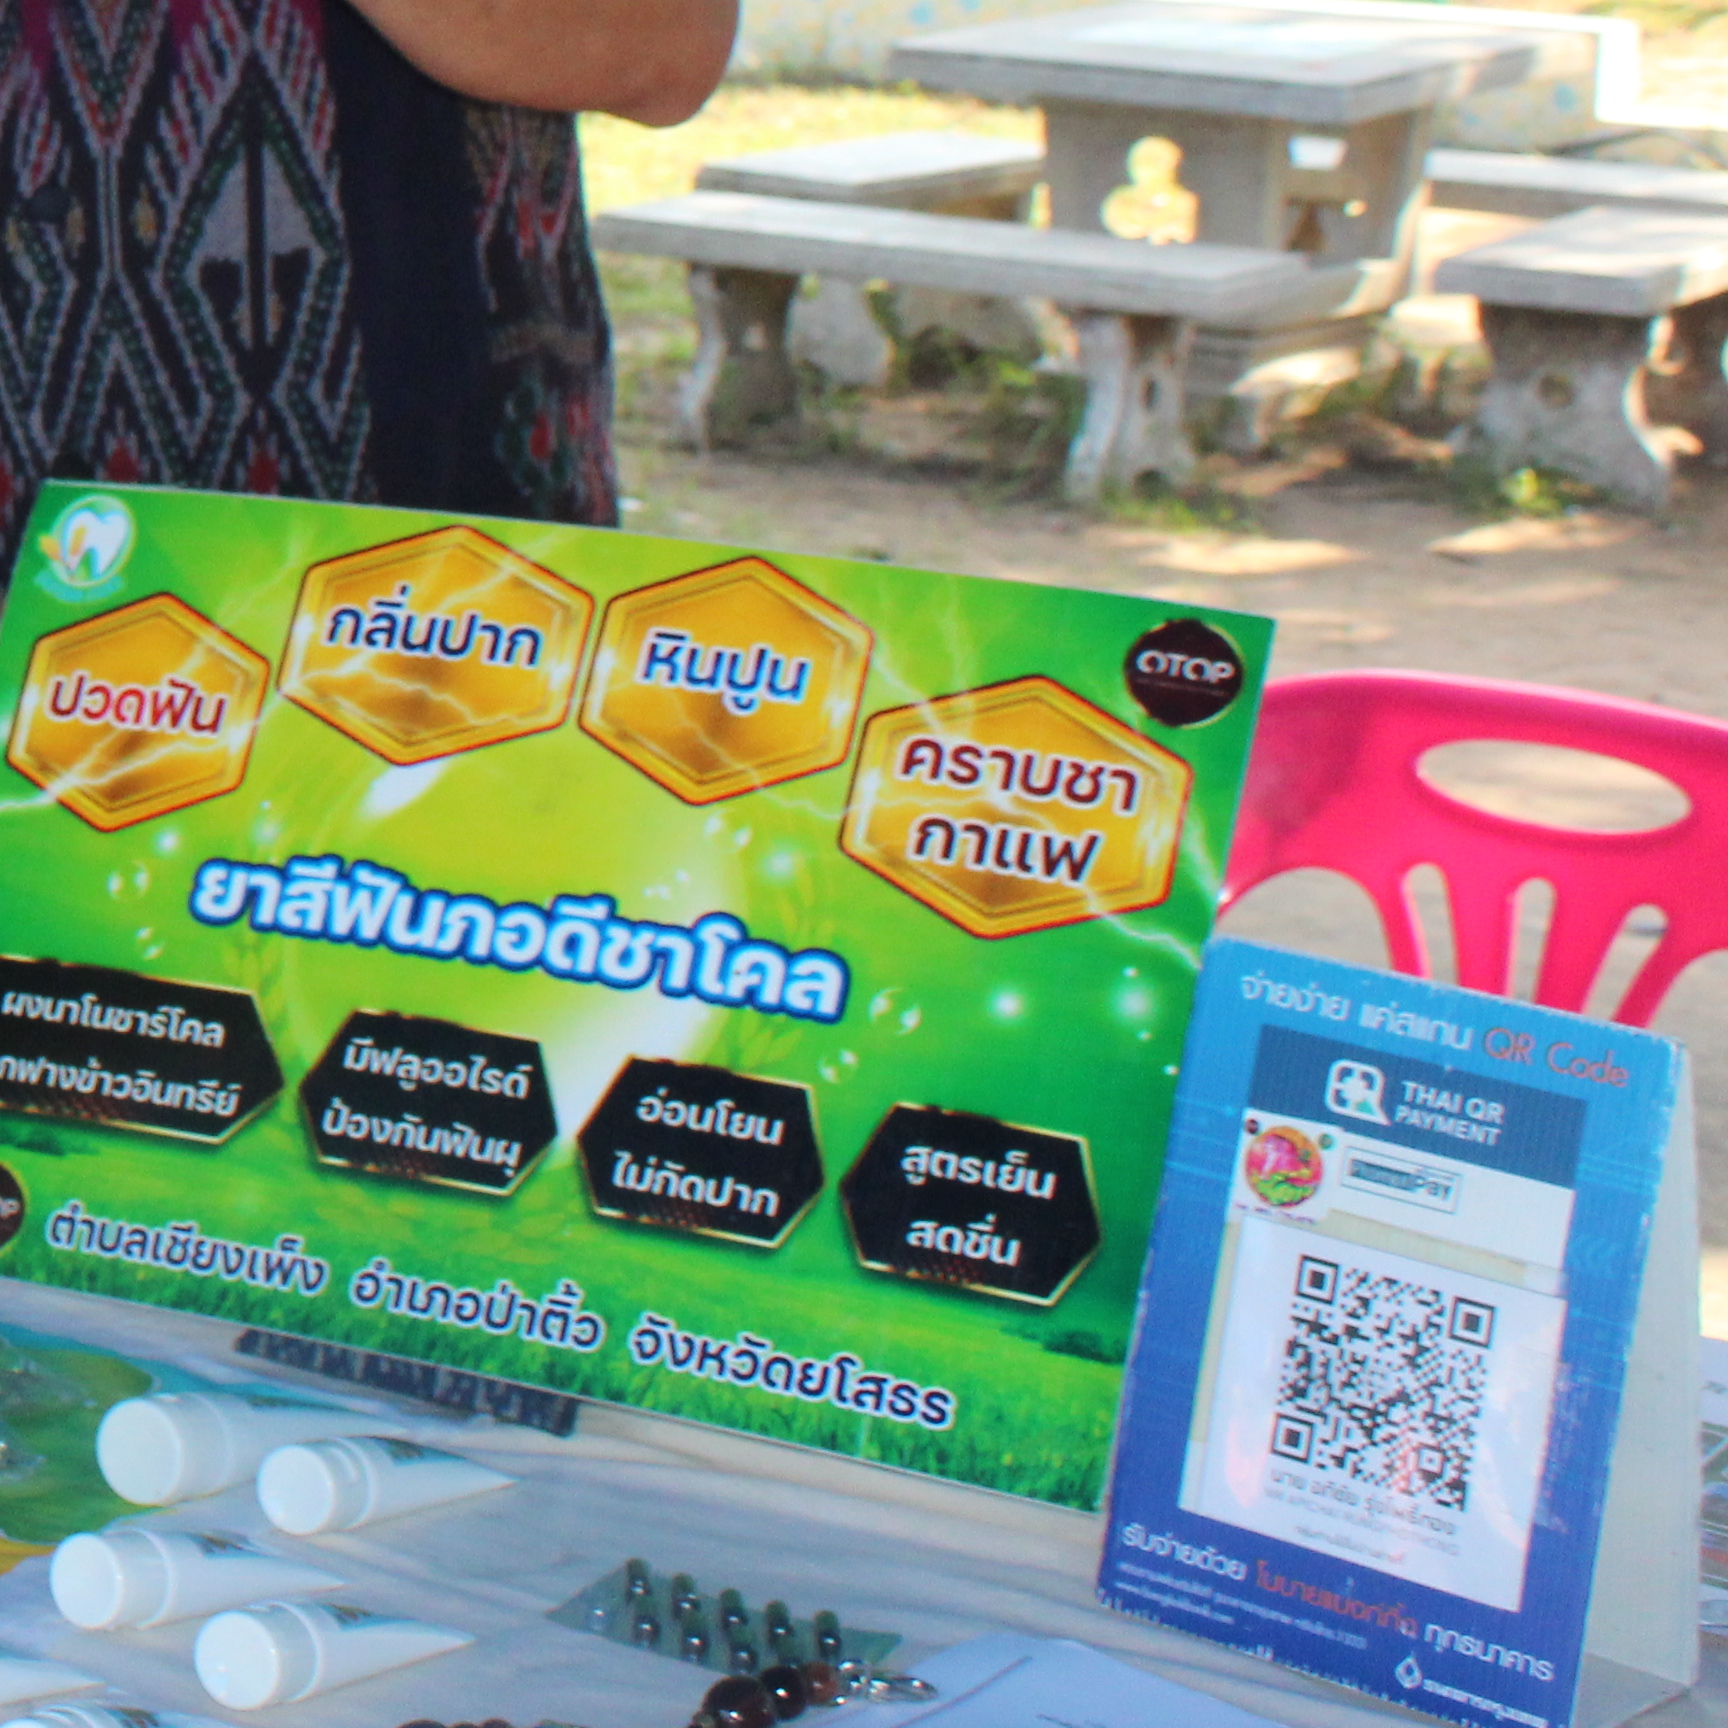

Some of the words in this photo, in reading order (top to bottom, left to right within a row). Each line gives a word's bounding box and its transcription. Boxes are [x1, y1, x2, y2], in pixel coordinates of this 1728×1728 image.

[324, 585, 542, 669] กลิ่นปาก
[641, 629, 809, 713] หินปูน
[1135, 649, 1235, 684] OTOP
[48, 673, 226, 736] ปวดฟัน
[899, 735, 1137, 814] คราบชา
[913, 814, 1100, 884] กาแฟ
[192, 856, 844, 1018] ยาสีฟันภอดีชาโคล
[0, 989, 227, 1050] ผงนาโนชาร์โคล
[1239, 971, 1353, 1022] จ่ายง่าย
[1483, 1026, 1536, 1067] QR
[1546, 1040, 1631, 1089] Code
[342, 1035, 535, 1100] มีฟลูออไรด์
[1399, 1078, 1464, 1116] THAI
[1465, 1093, 1507, 1126] QR
[321, 1095, 524, 1179] ป้องกันฟันผุ
[635, 1085, 786, 1147] อ่อนโยน
[1394, 1104, 1503, 1148] PAYMENT
[611, 1148, 781, 1218] ไม่กัดปาก
[899, 1144, 1057, 1201] สูตรเย็น
[905, 1212, 1023, 1268] สดชื่น
[49, 1200, 328, 1295] ตำบลเชียงเพ็ง
[351, 1259, 605, 1353] อำเภอป่าติ้ว
[630, 1314, 955, 1430] จังหวัดยโสธร
[1120, 1521, 1248, 1581] รับจ่ายด้วย
[1423, 1622, 1556, 1682] ทุกธนาคาร
